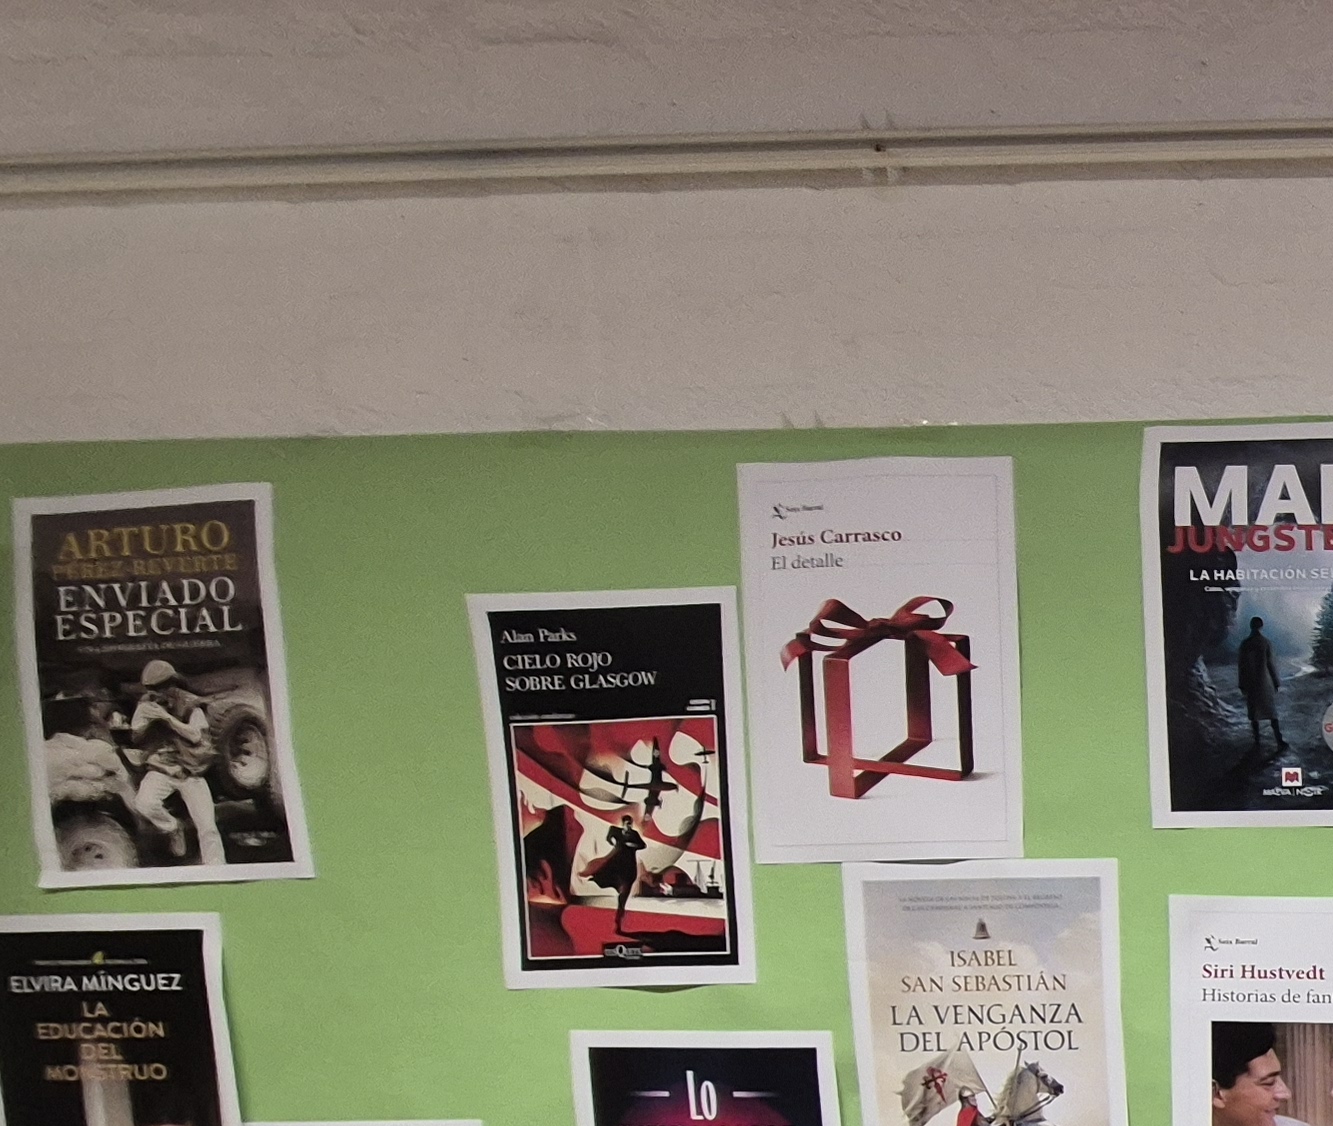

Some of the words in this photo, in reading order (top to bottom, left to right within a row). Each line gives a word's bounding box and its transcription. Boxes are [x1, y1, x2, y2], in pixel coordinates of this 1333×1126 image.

[58, 520, 230, 560] ARTURO
[772, 531, 815, 549] Jesús
[821, 530, 901, 544] Carrasco
[1190, 569, 1210, 581] LA
[1214, 565, 1306, 581] HABITACIÓN
[58, 577, 235, 612] ENVIADO
[55, 606, 242, 640] ESPECIAL
[503, 654, 561, 670] CIELO
[567, 652, 612, 671] ROJO
[505, 676, 565, 691] SOBRE
[570, 671, 657, 689] GLASGOW
[9, 975, 77, 993] ELVIRA
[82, 970, 183, 992] MÍNGUEZ
[1202, 964, 1234, 979] Siri
[1241, 965, 1325, 980] Hustvedt
[1202, 988, 1276, 1003] Historias
[1281, 990, 1300, 1004] de
[890, 1005, 924, 1025] LA
[933, 1002, 1083, 1025] VENGANZA
[36, 1017, 165, 1039] EDUCACIÓN
[900, 1032, 947, 1052] DEL
[956, 1027, 1079, 1051] APÓSTOL
